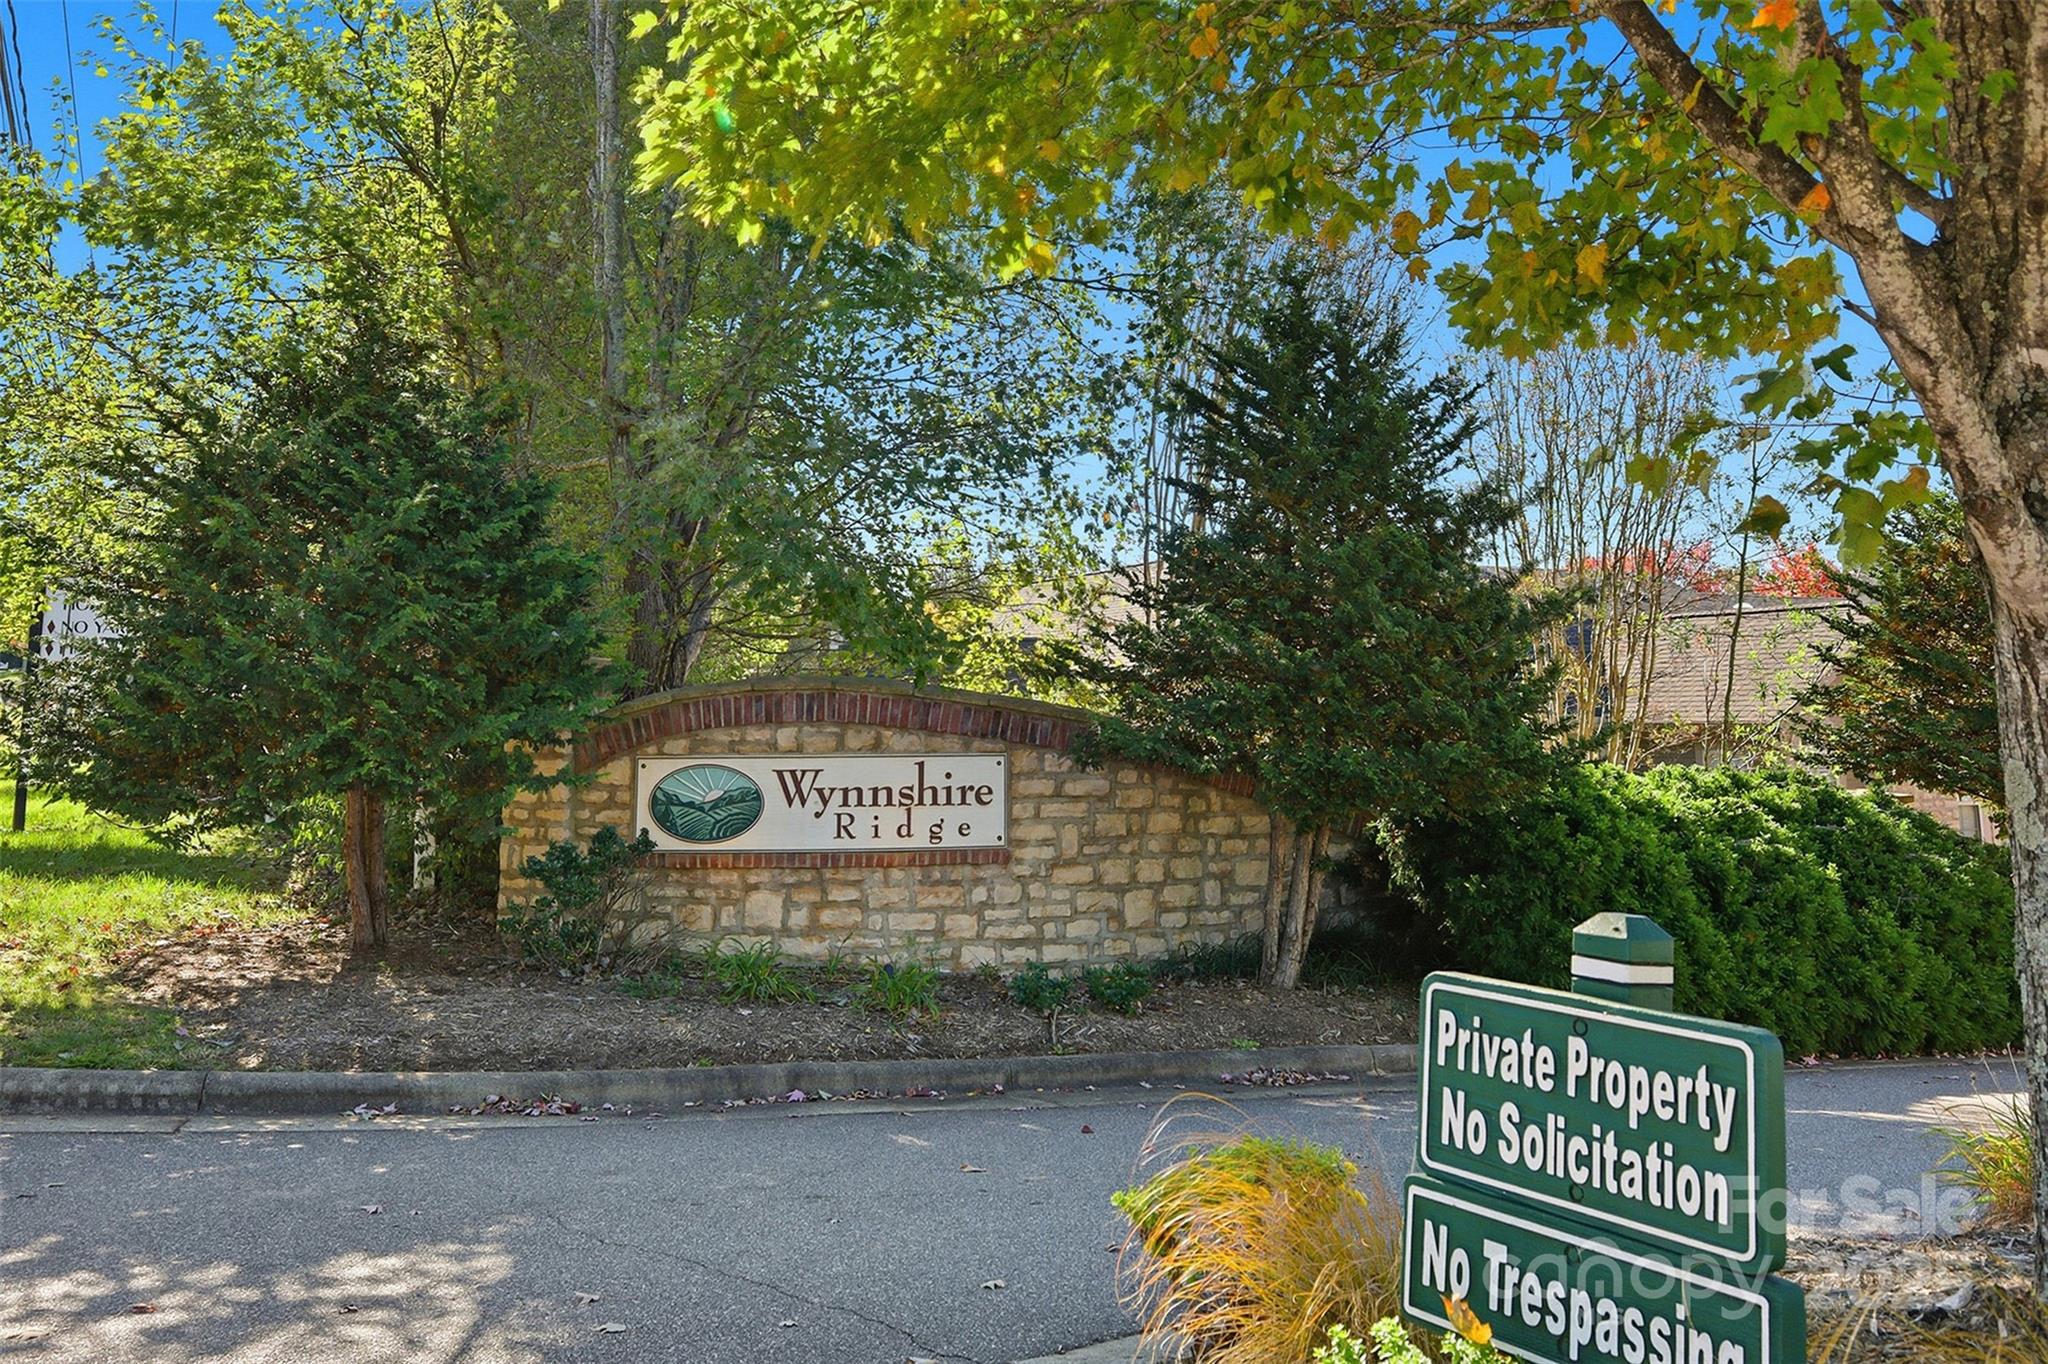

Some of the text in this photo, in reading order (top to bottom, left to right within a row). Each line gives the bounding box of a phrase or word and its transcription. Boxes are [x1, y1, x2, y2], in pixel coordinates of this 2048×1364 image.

[62, 620, 88, 634] NO
[772, 760, 994, 819] Wynnshire
[833, 808, 971, 845] Ridge
[1437, 1009, 1736, 1152] Private Property
[1440, 1086, 1729, 1225] No Solicitation
[1422, 1218, 1470, 1302] No
